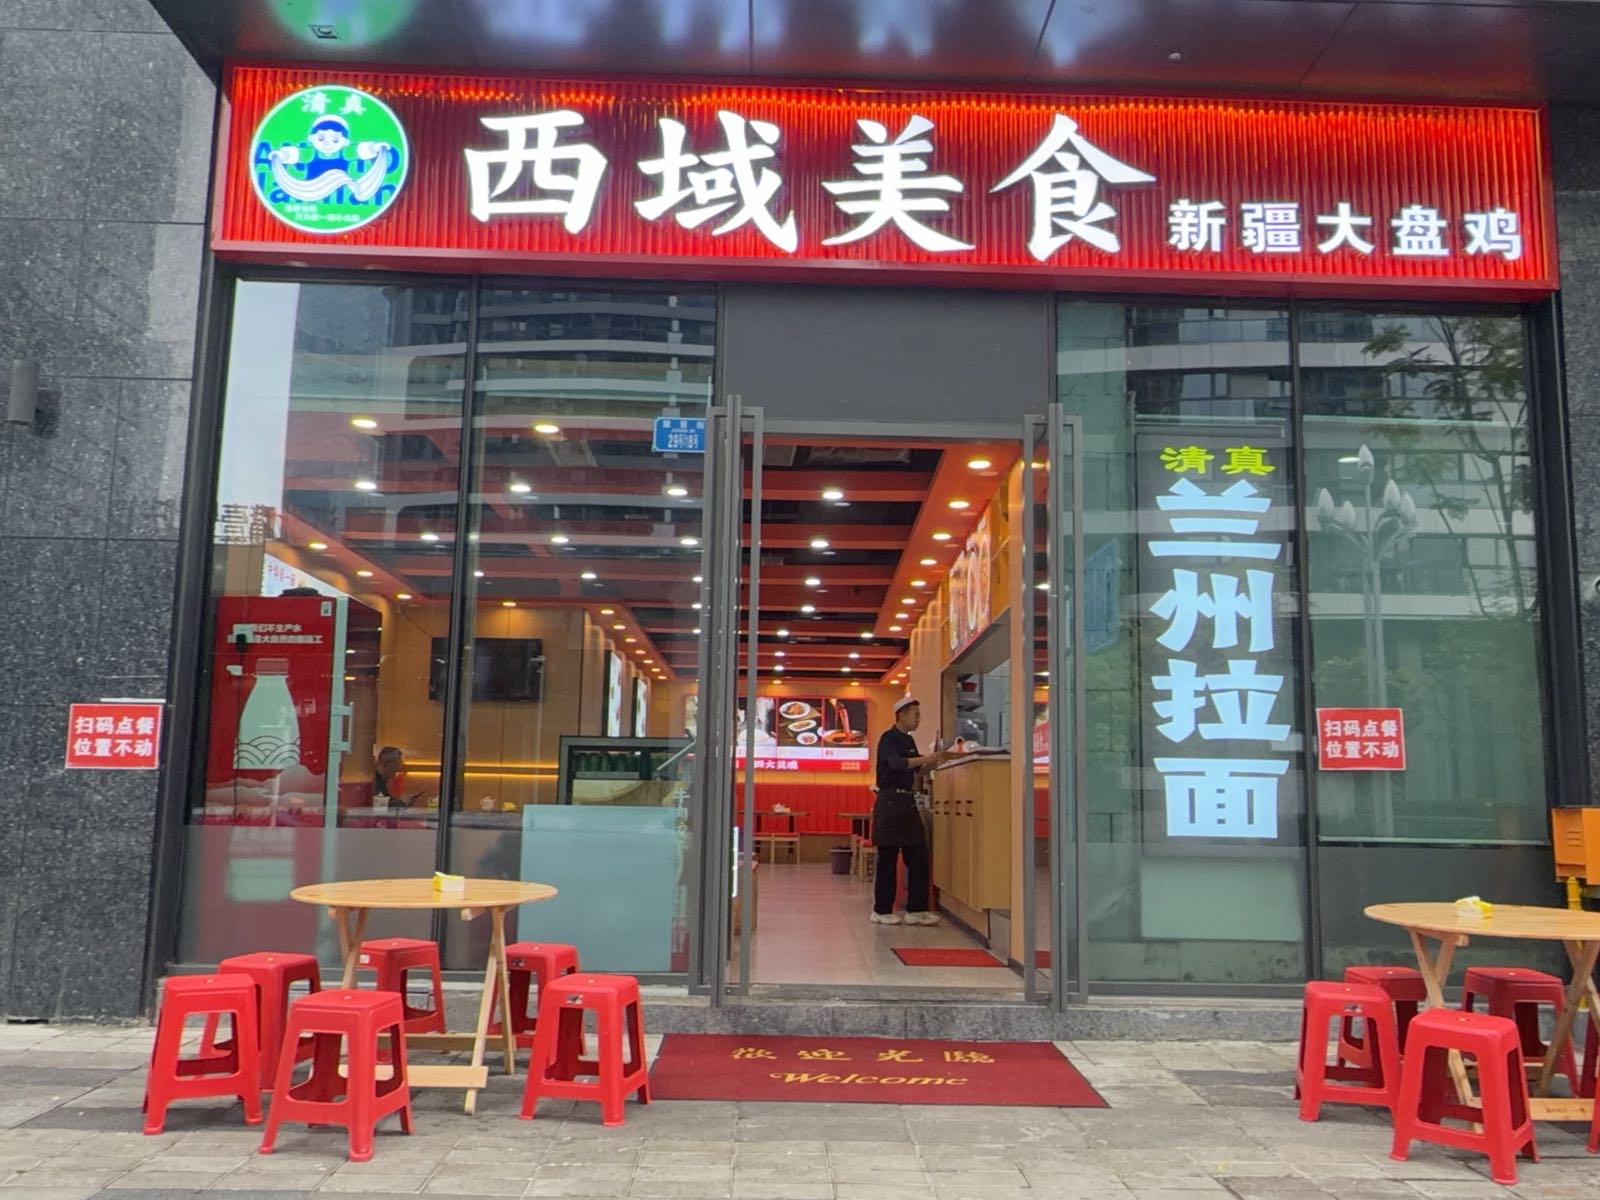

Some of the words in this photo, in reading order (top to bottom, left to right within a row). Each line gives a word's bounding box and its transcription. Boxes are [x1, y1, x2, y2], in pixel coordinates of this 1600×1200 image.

[301, 91, 367, 115] 清真
[463, 110, 1156, 262] 西域美食
[1168, 199, 1522, 260] 新疆大盘鸡
[1159, 446, 1276, 476] 清真
[1147, 477, 1292, 839] 兰州拉面
[75, 716, 155, 735] 扫码点餐
[1324, 719, 1398, 738] 扫码点餐
[73, 737, 153, 757] 位置不动
[1325, 740, 1400, 759] 位置不动
[769, 1072, 969, 1086] Welcome
